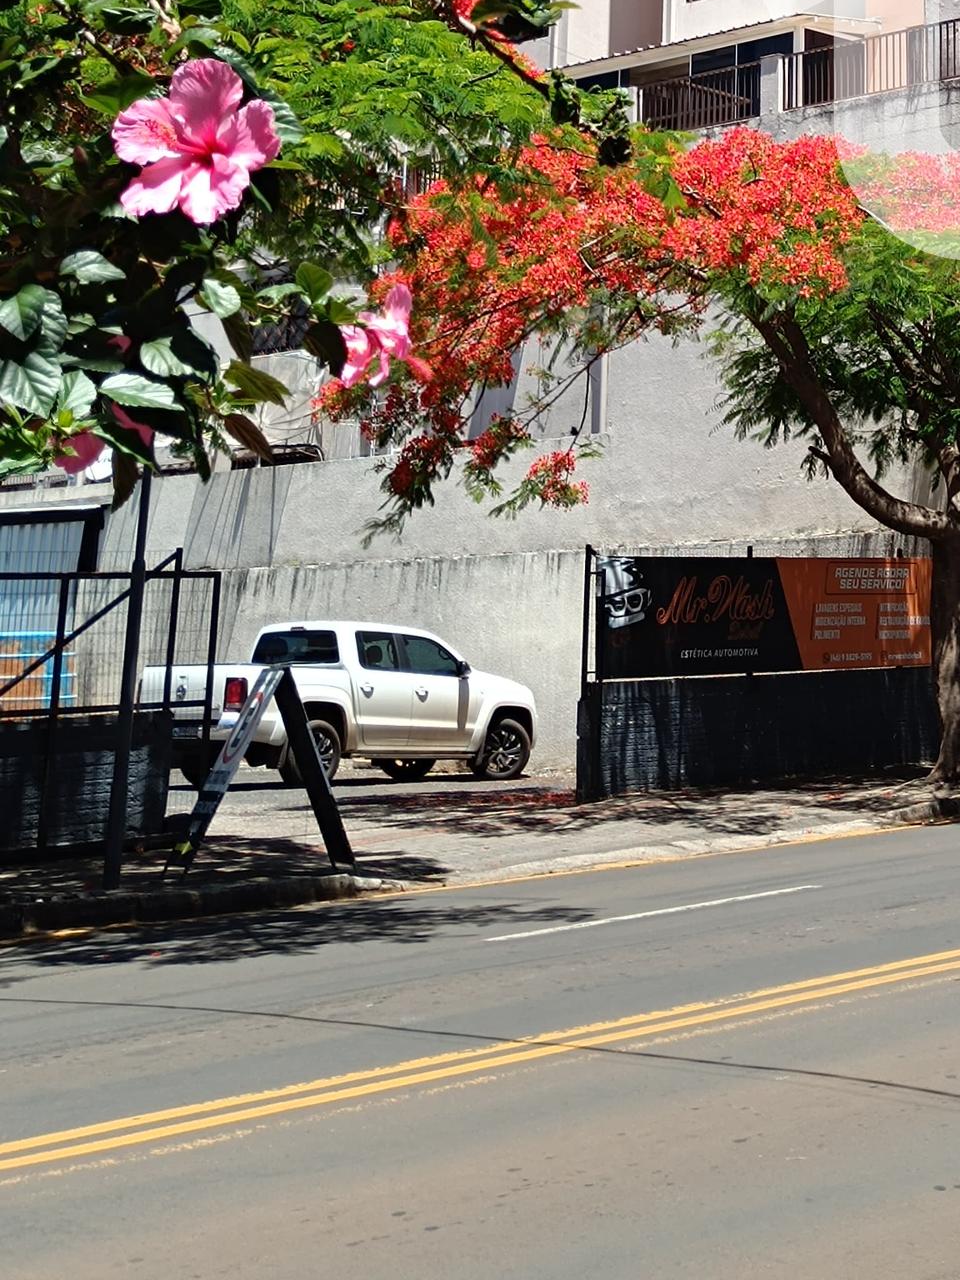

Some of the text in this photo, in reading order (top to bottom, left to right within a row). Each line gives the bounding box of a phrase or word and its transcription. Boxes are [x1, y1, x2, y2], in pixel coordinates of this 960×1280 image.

[835, 567, 909, 579] AGENDE AGORA
[839, 578, 905, 591] SEU SERVIÇO!
[680, 647, 759, 659] ESTÉTICA AUTOMOTIVA
